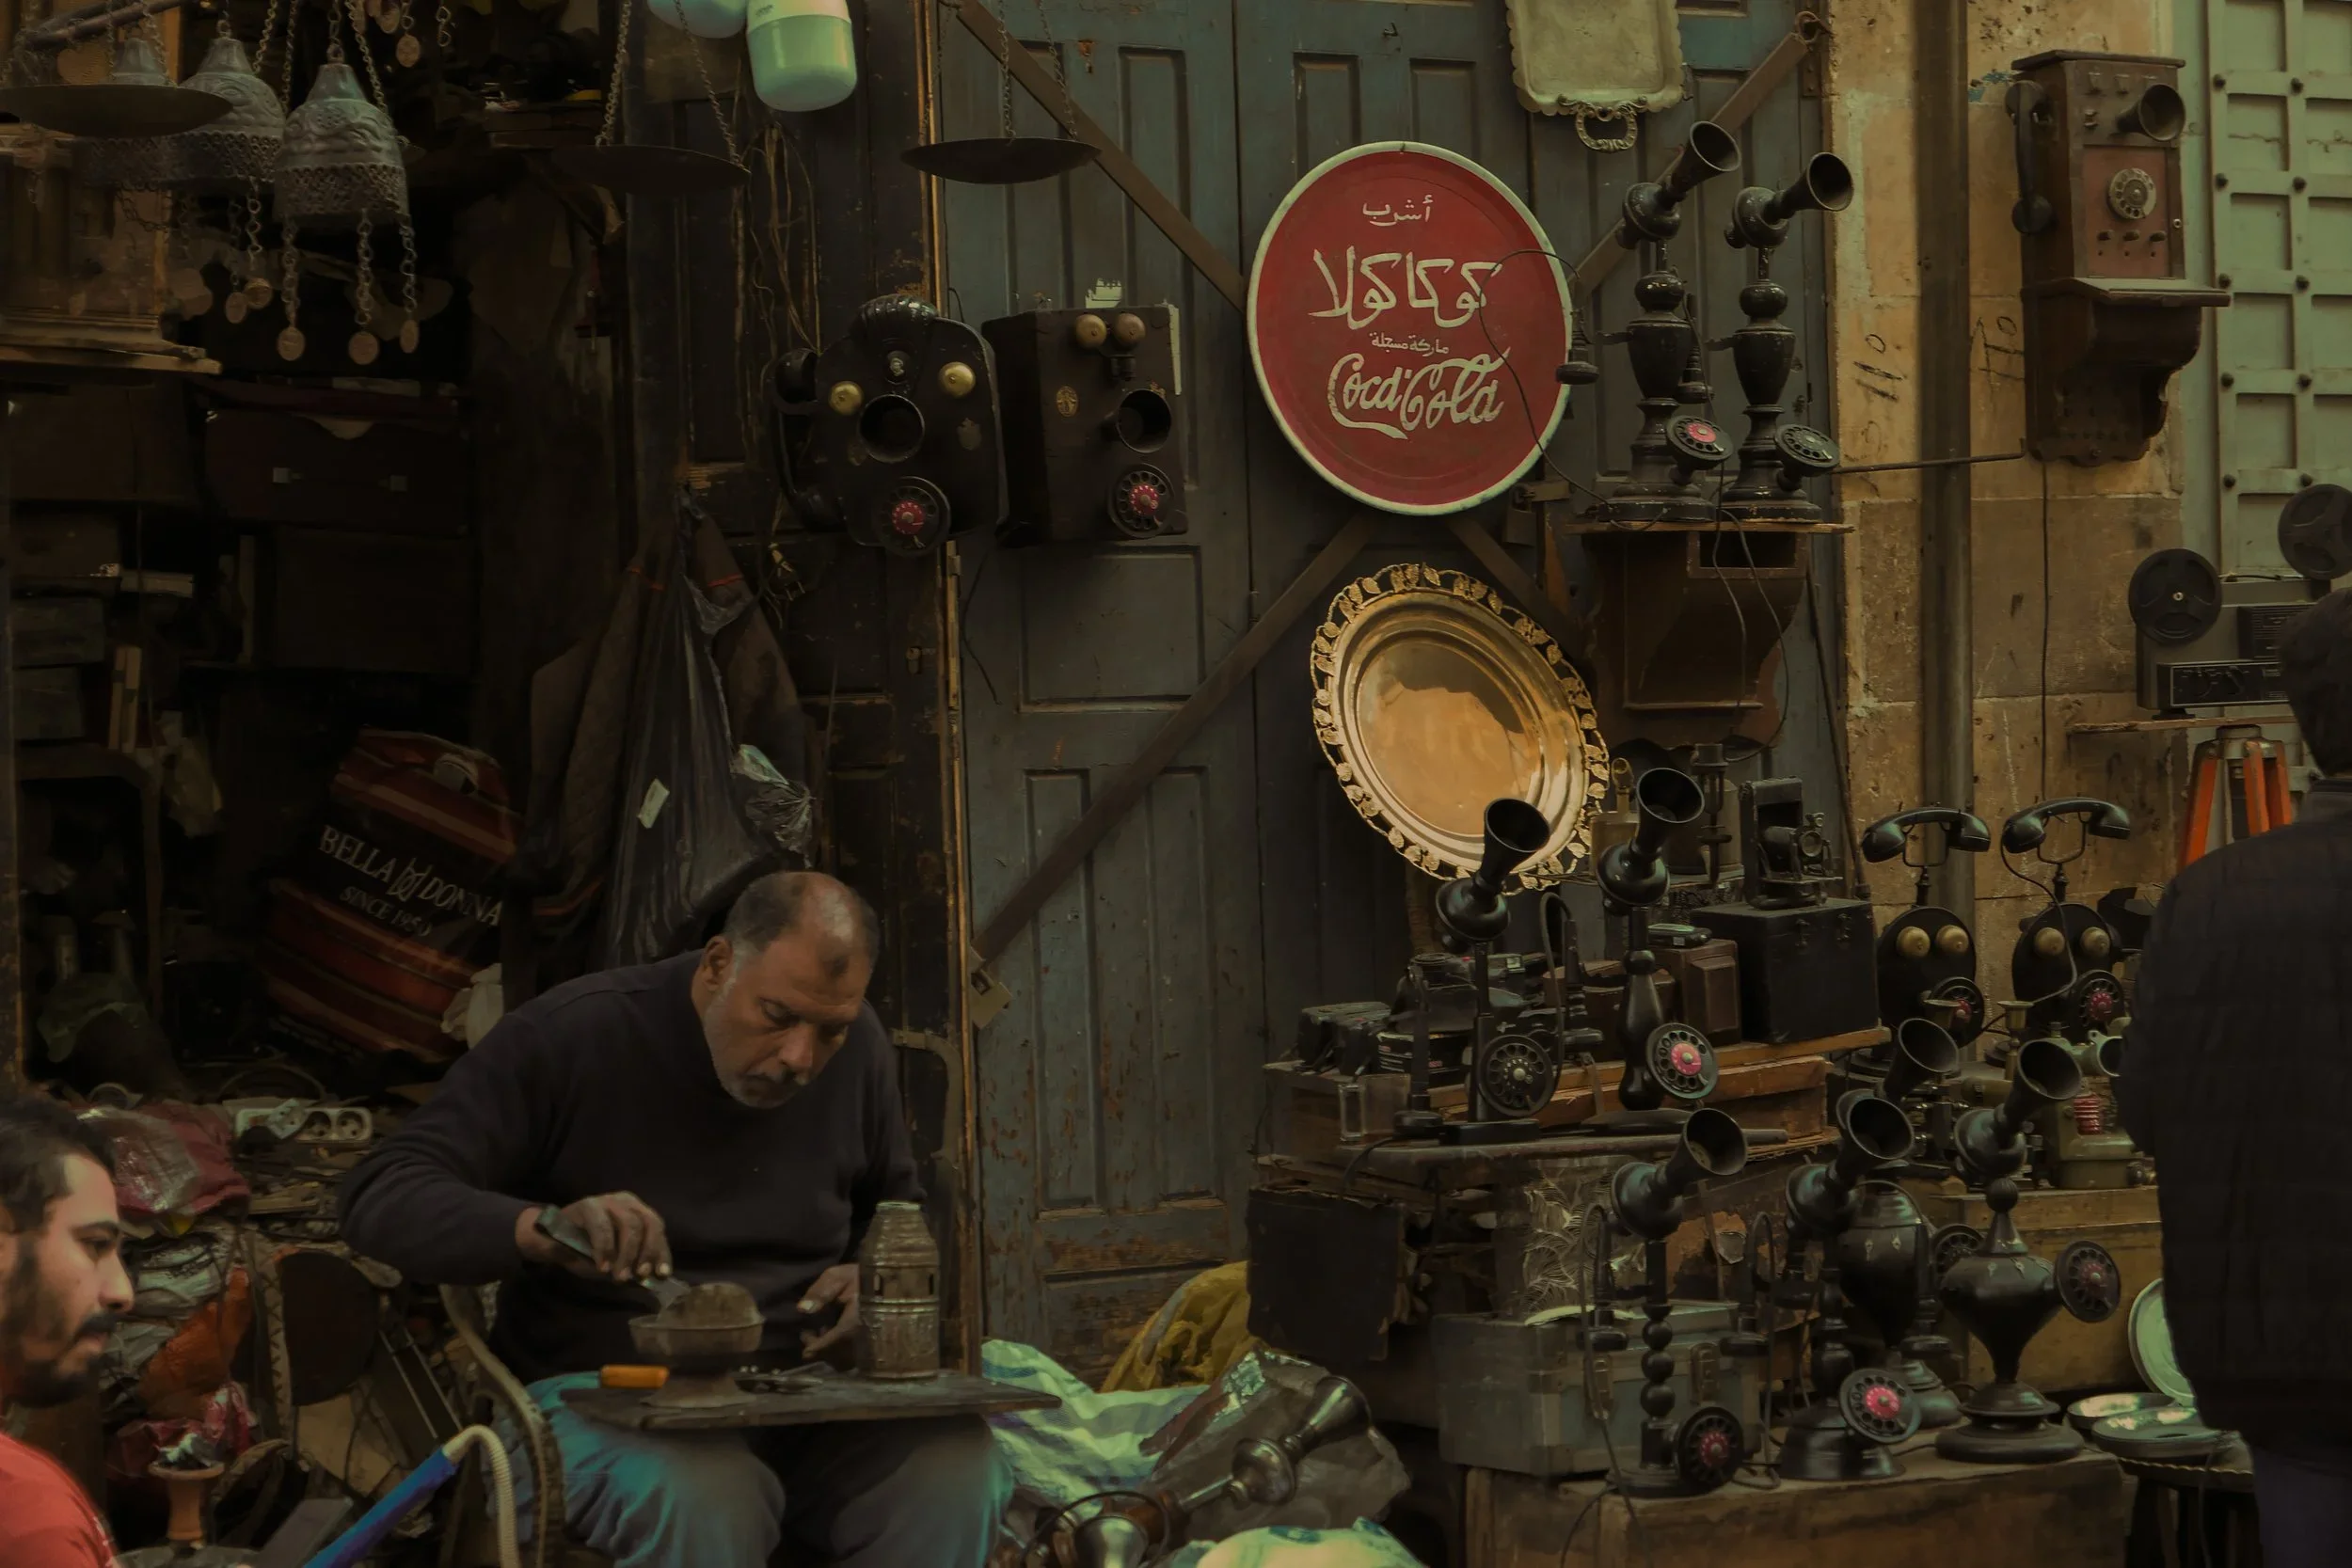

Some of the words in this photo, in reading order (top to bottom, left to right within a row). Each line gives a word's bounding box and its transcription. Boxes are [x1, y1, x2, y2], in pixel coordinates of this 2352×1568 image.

[1362, 194, 1434, 226] أشرب
[317, 824, 399, 885] BELLA
[417, 876, 503, 927] DONNA
[339, 885, 396, 921] SINCE
